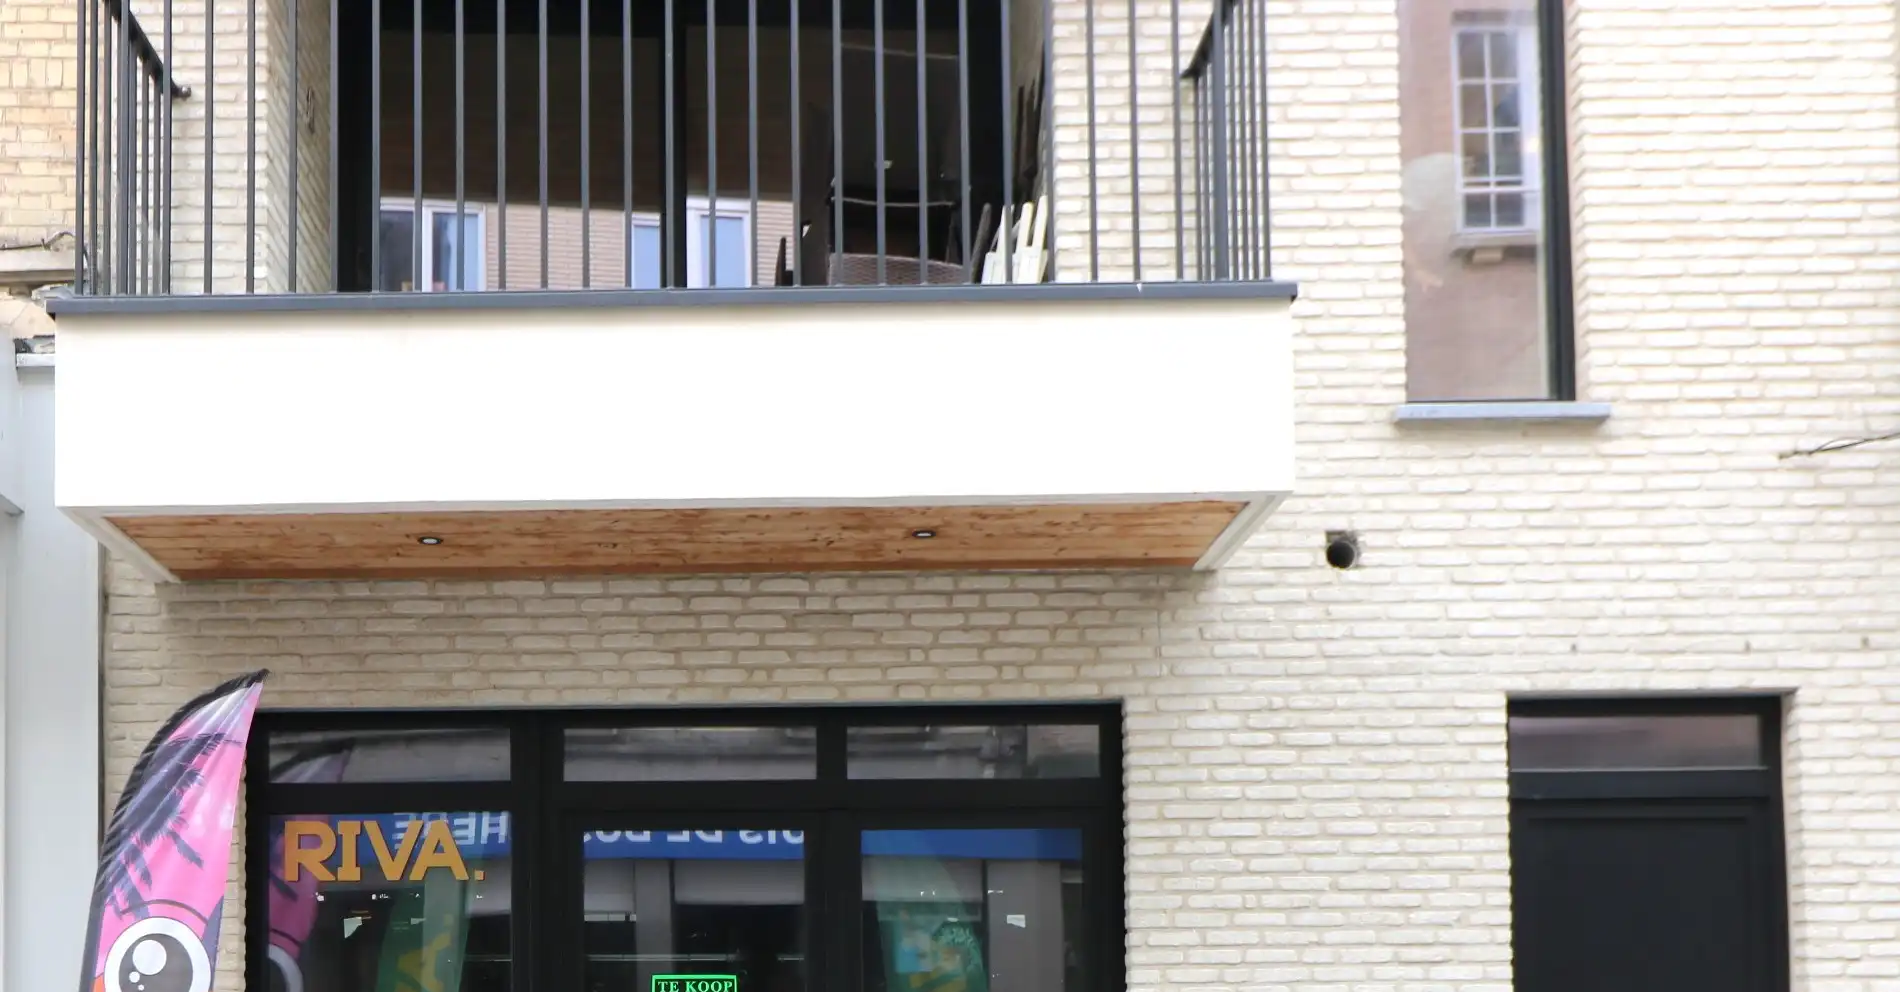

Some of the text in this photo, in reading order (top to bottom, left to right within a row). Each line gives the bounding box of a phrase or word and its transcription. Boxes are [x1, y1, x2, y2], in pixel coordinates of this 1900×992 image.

[283, 820, 485, 882] RIVA.
[657, 980, 733, 992] TE KOOP
